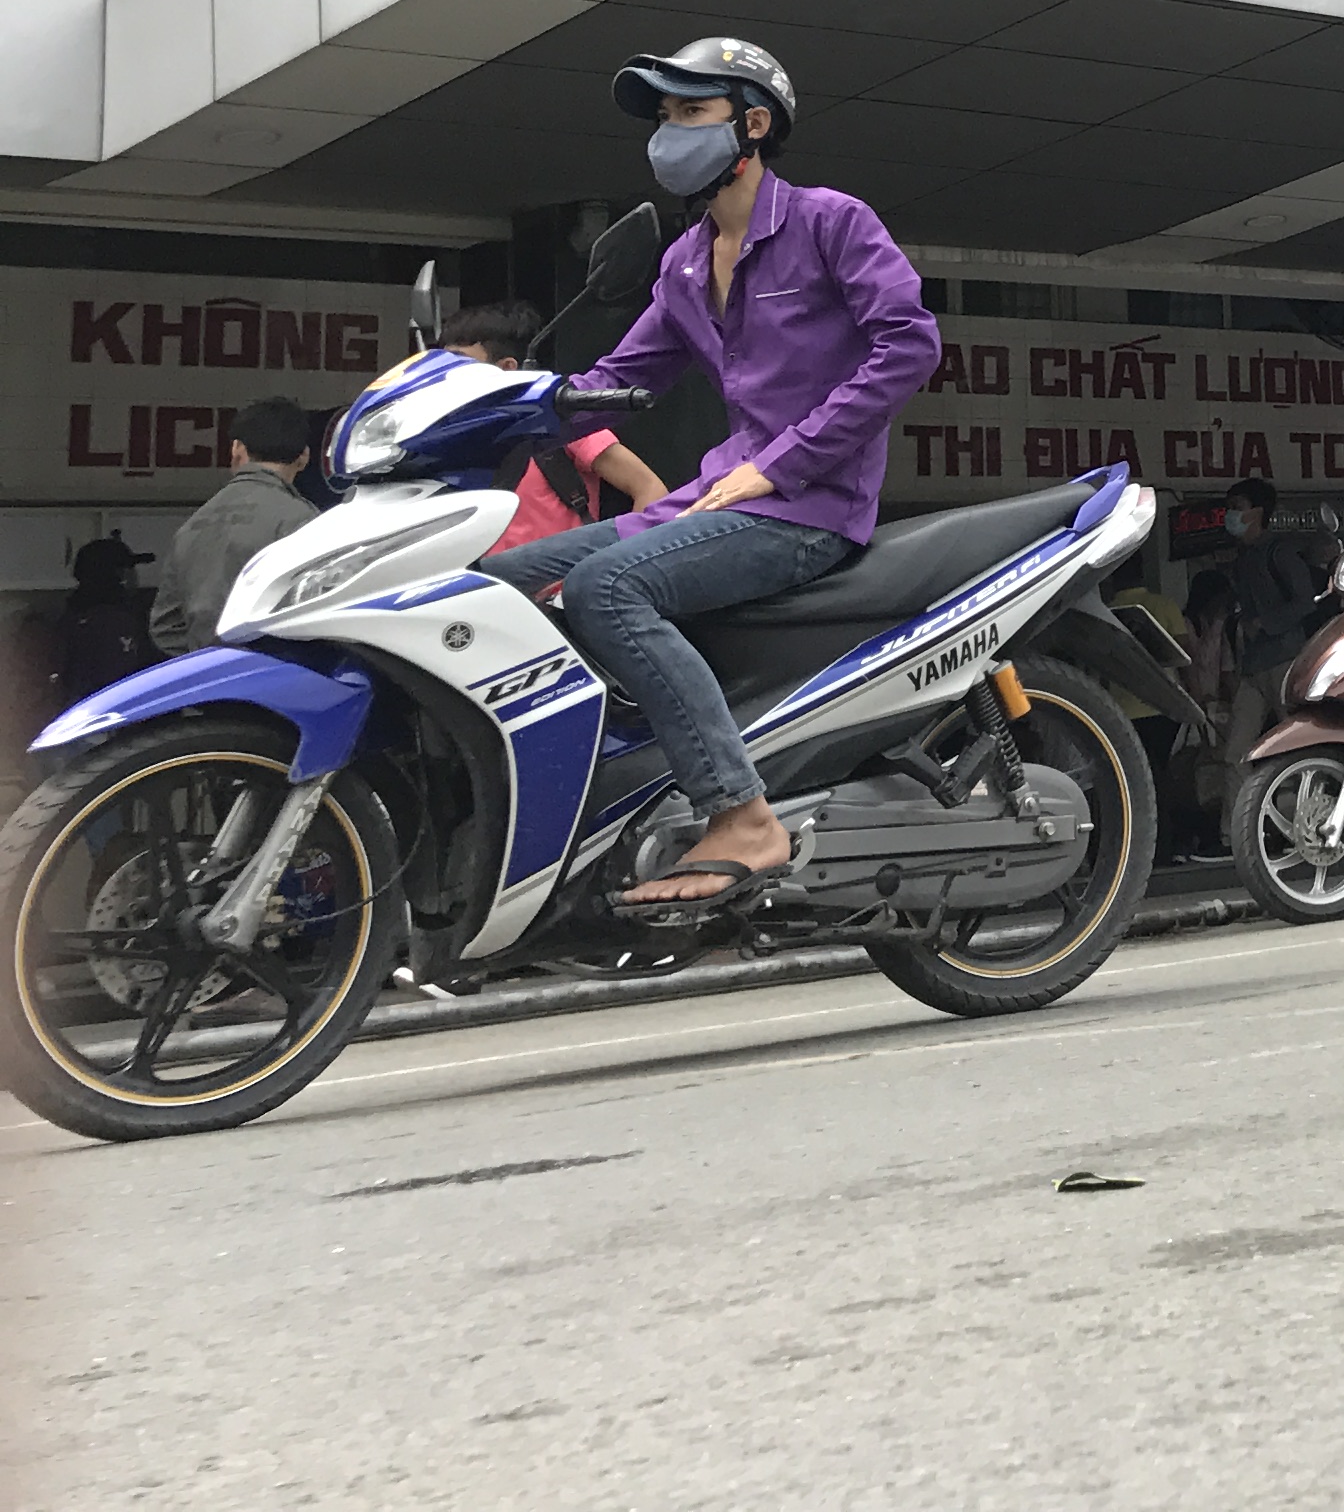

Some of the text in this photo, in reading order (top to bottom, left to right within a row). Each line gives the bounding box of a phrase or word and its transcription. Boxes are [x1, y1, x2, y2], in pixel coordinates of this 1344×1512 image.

[71, 297, 379, 372] KHÔNG
[917, 343, 1010, 395] AO
[1030, 334, 1176, 400] CHẤT
[903, 424, 1002, 476] THI
[1023, 427, 1143, 478] ĐUA
[1164, 417, 1274, 478] CỦA
[860, 567, 1018, 665] JUPITER
[483, 657, 567, 705] GP
[906, 622, 1000, 692] YAMAHA
[530, 677, 587, 707] EDITION
